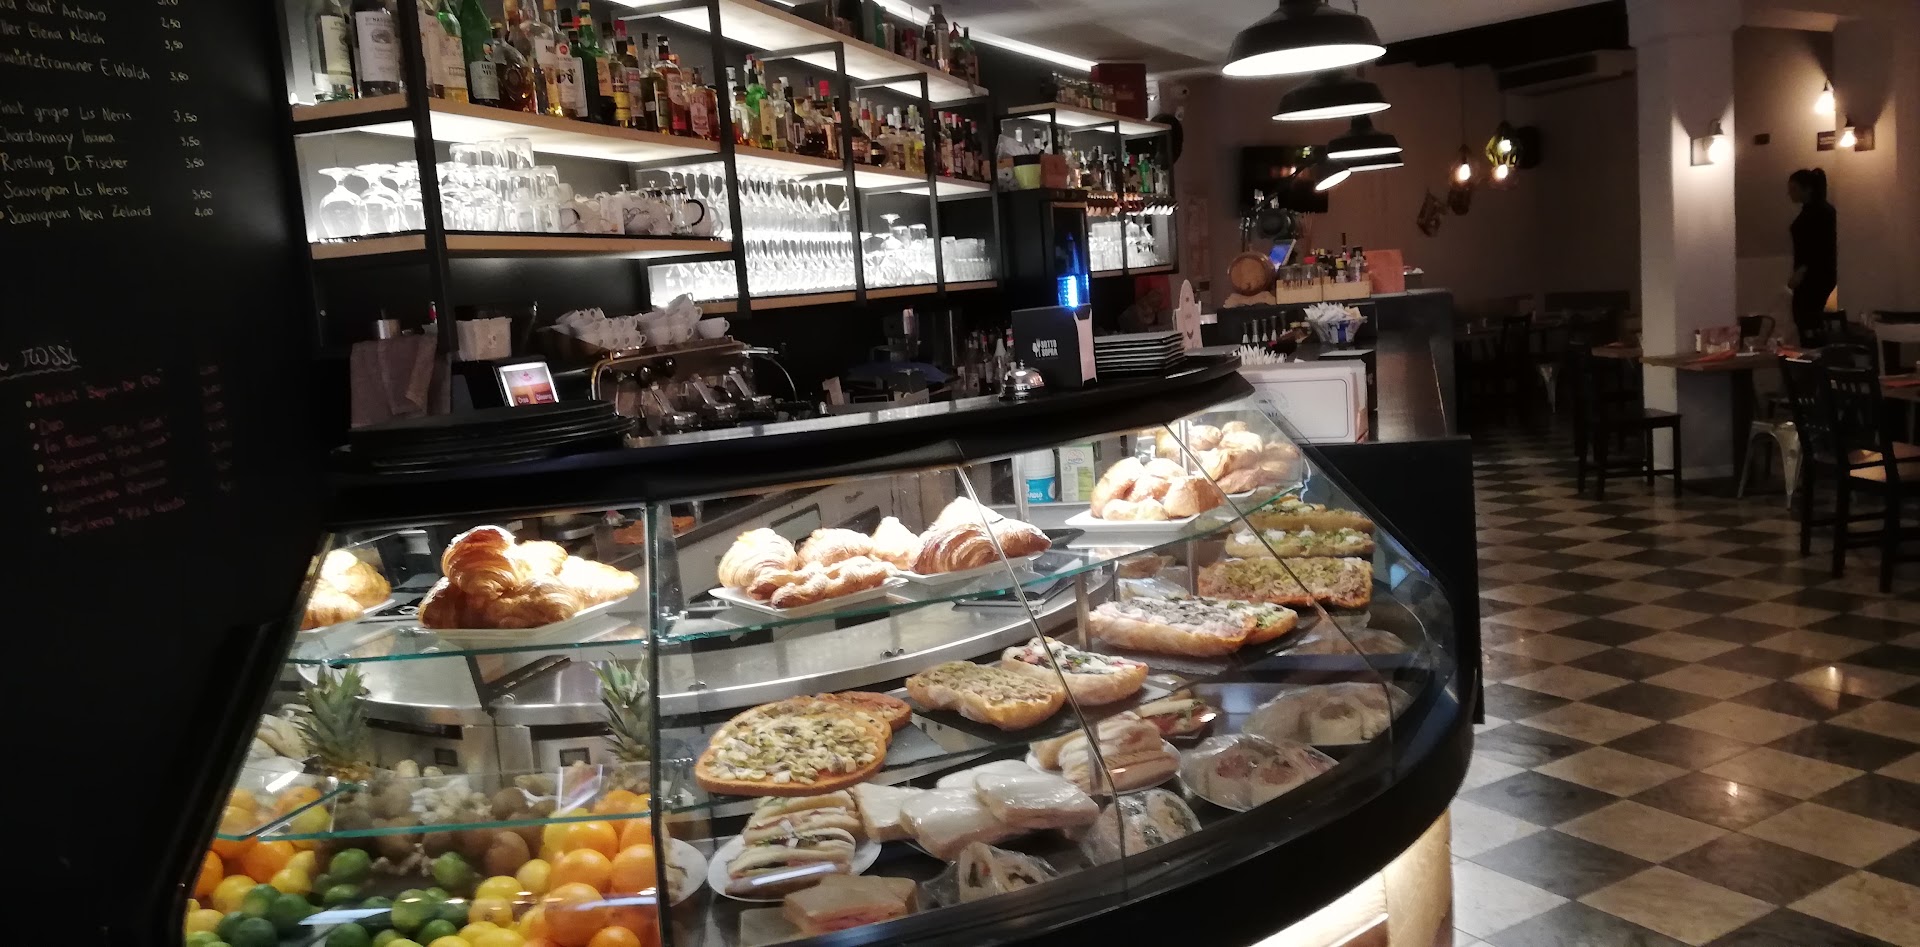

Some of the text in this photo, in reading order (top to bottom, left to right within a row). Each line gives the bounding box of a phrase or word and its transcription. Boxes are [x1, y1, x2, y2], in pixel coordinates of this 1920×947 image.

[62, 3, 107, 22] Antonio
[28, 21, 63, 40] Elena
[68, 25, 106, 44] Walch
[114, 63, 150, 81] Walch
[34, 107, 69, 123] grigio
[79, 106, 96, 121] Lis
[102, 107, 133, 122] Neris
[0, 125, 74, 153] Chardonnay
[0, 152, 55, 175] Riesling
[86, 155, 128, 170] Fischer
[3, 180, 69, 202] Sauvignon
[74, 181, 93, 197] Lis
[98, 182, 129, 197] Neris
[8, 204, 71, 228] Sauvignon
[79, 207, 103, 221] New
[112, 204, 151, 218] Zeland
[1040, 339, 1057, 348] SOTTO
